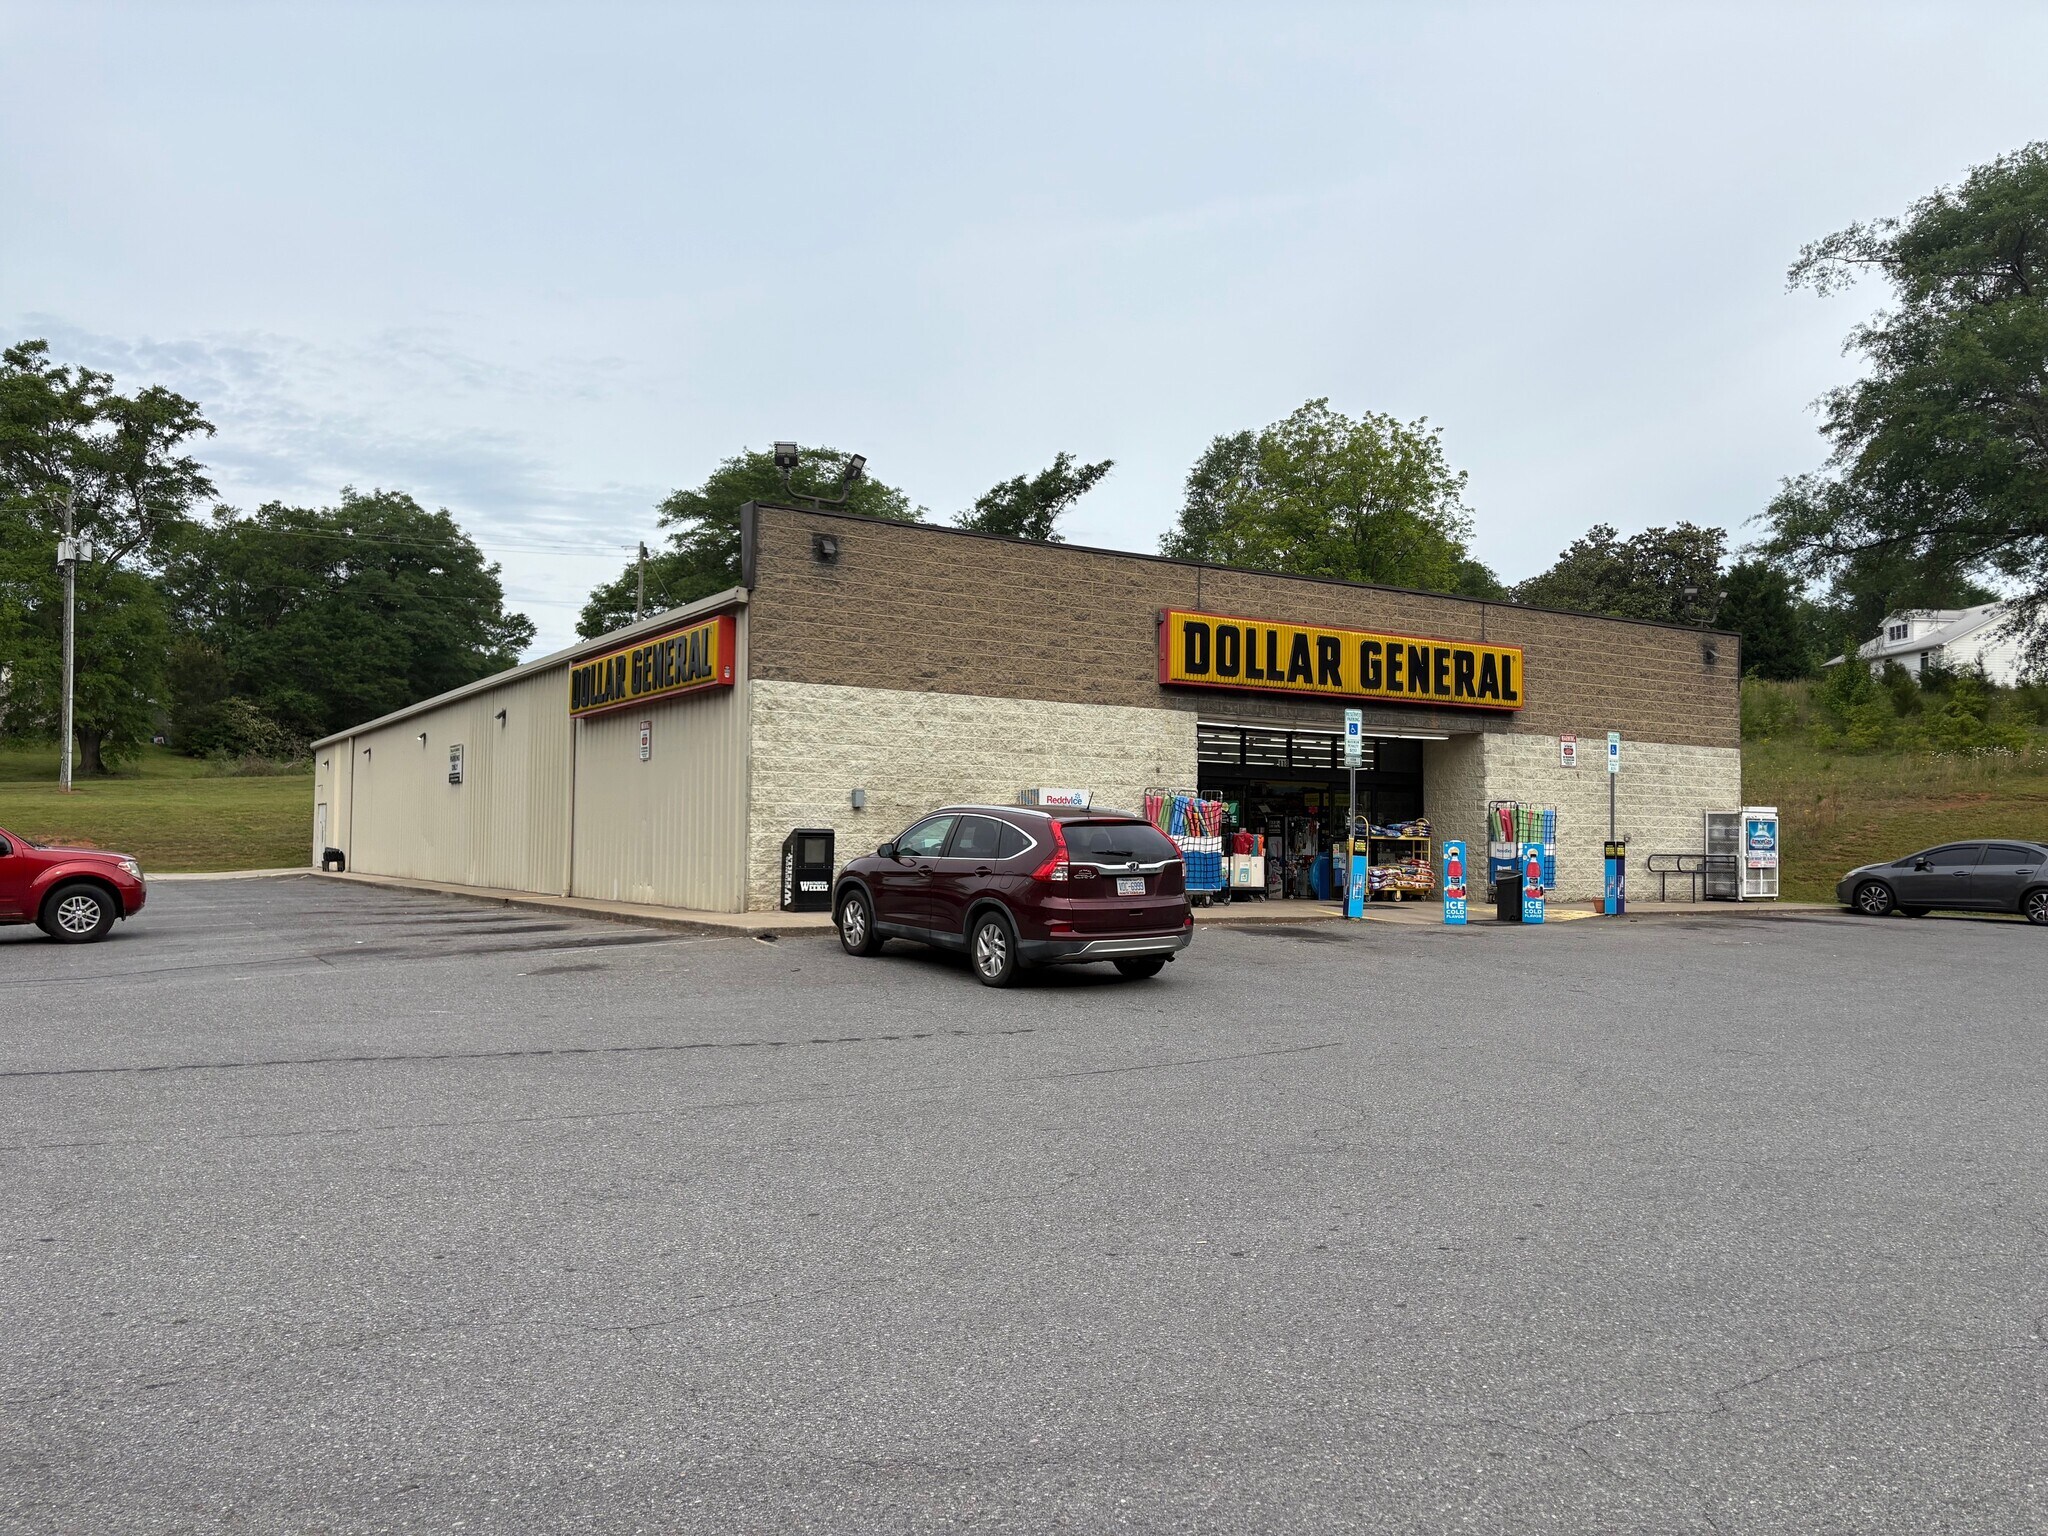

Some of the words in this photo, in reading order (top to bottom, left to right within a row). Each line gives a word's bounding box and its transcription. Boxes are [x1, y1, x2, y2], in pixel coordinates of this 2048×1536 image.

[1184, 621, 1342, 686] DOLLAR
[1360, 640, 1518, 700] GENERAL
[572, 655, 626, 709] DOLLAR
[631, 628, 711, 694] GENERAL
[799, 881, 829, 892] WEEKLY
[1446, 901, 1465, 909] ICE
[1524, 901, 1542, 909] ICE
